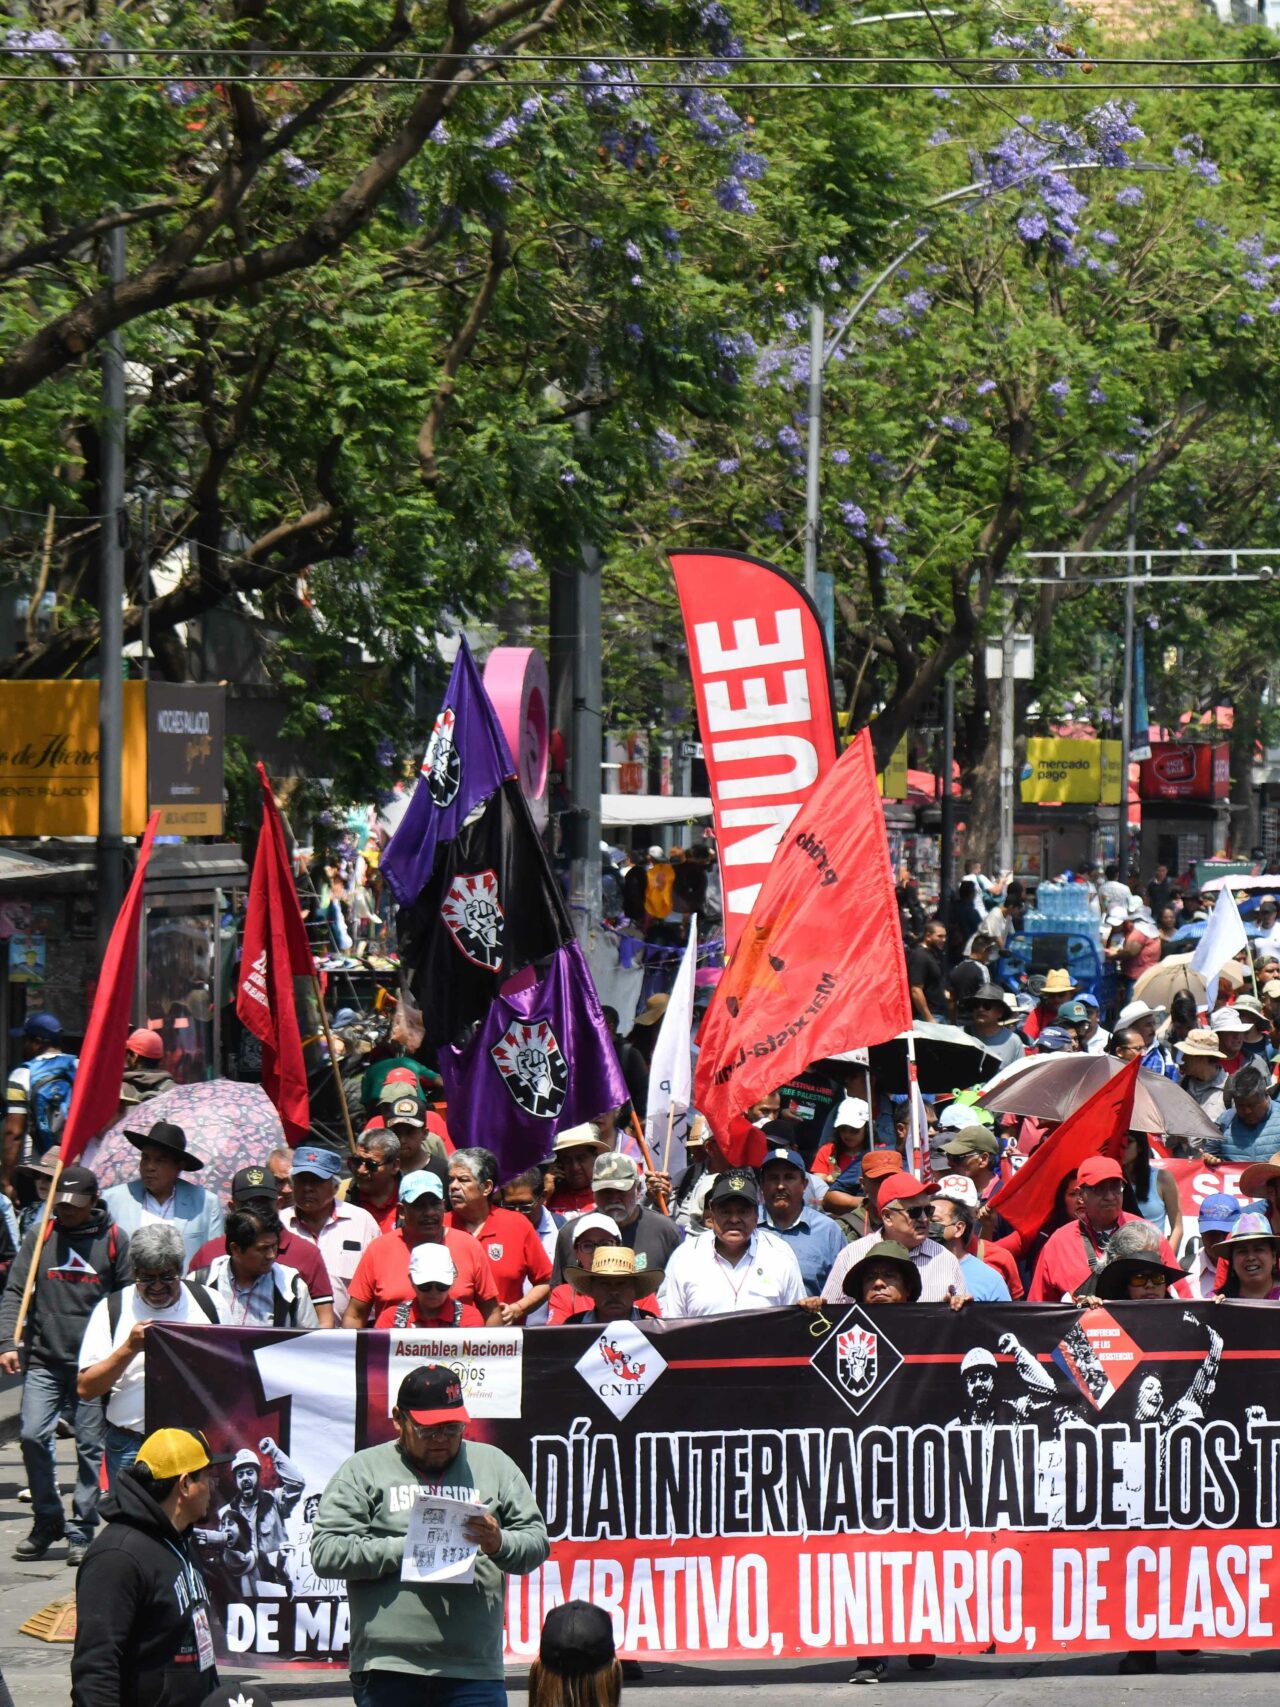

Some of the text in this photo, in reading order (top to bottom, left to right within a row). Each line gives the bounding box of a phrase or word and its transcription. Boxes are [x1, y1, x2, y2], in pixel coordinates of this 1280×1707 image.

[695, 607, 820, 916] NUEE
[1037, 758, 1090, 771] mercado
[1037, 771, 1068, 783] pago
[395, 1339, 518, 1358] Asamblea Nacional
[599, 1384, 647, 1398] CNTE
[530, 1417, 626, 1543] DÍA
[634, 1424, 1051, 1542] INTERNACIONAL
[1062, 1423, 1131, 1531] DE
[1142, 1420, 1242, 1531] LOS
[503, 1553, 784, 1656] OMBATIVO,
[799, 1549, 1037, 1651] UNITARIO,
[1052, 1546, 1112, 1640] DE
[1125, 1544, 1274, 1640] CLASE
[226, 1601, 351, 1653] DE MA
